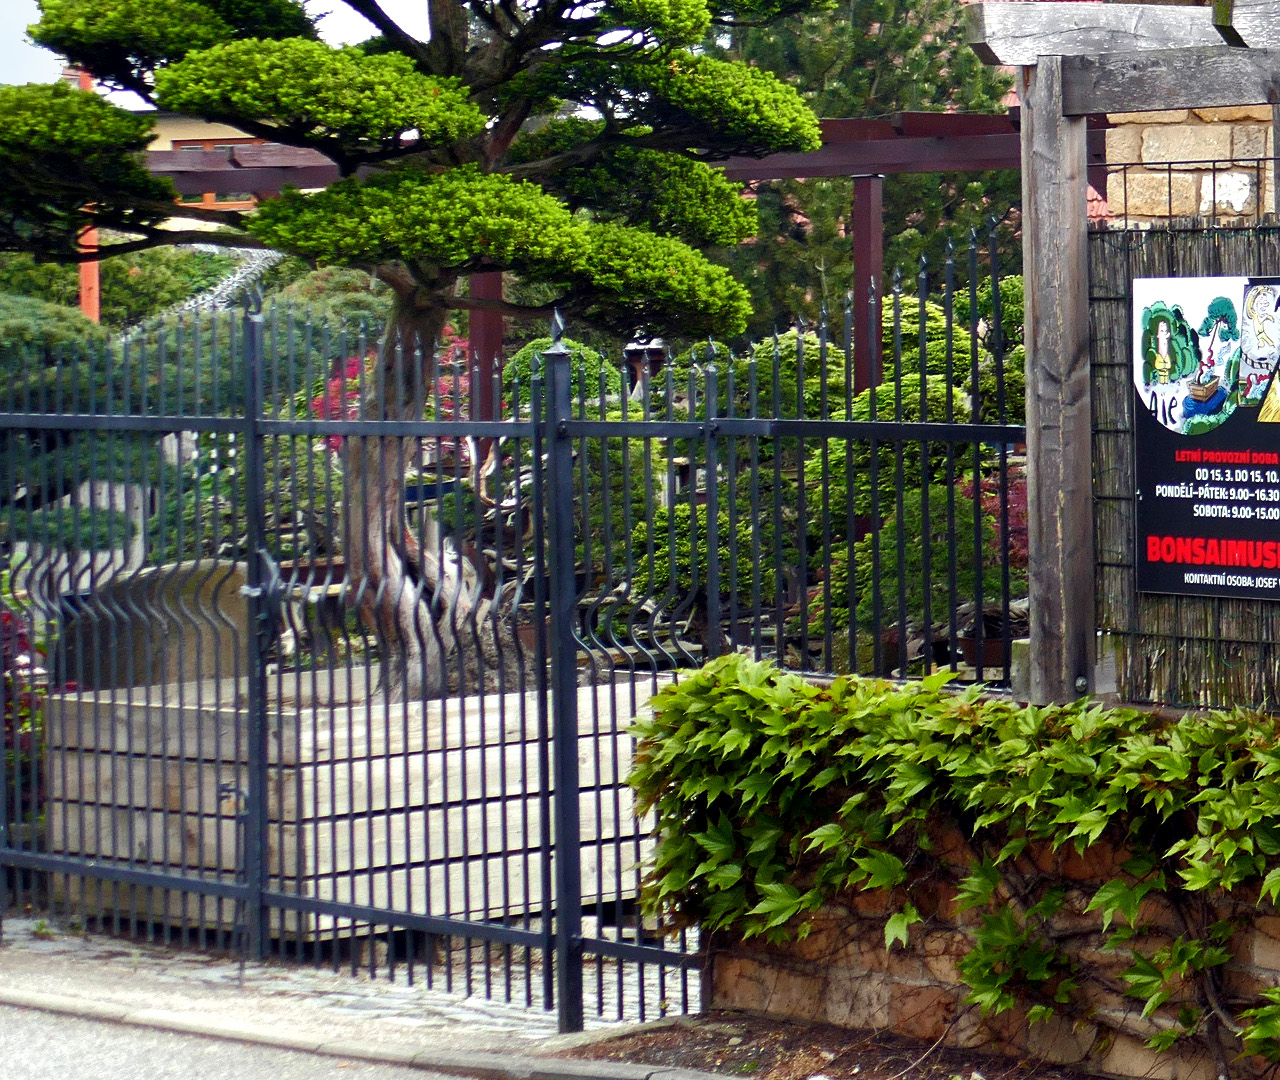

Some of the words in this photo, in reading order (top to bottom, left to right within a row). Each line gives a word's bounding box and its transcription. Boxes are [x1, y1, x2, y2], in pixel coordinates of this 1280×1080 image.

[1175, 449, 1201, 463] LETNÍ
[1202, 450, 1250, 464] PROVOZNÍ
[1252, 452, 1280, 465] DOBA
[1195, 468, 1209, 481] OD
[1210, 469, 1224, 482] 15.
[1225, 470, 1234, 482] 3.
[1235, 470, 1249, 483] DO
[1249, 471, 1264, 483] 15.
[1265, 471, 1280, 484] 10.
[1193, 504, 1231, 518] SOBOTA:
[1184, 573, 1226, 586] KONTAKTNÍ
[1226, 576, 1254, 587] OSOBA:
[1254, 577, 1278, 589] JOSEF
